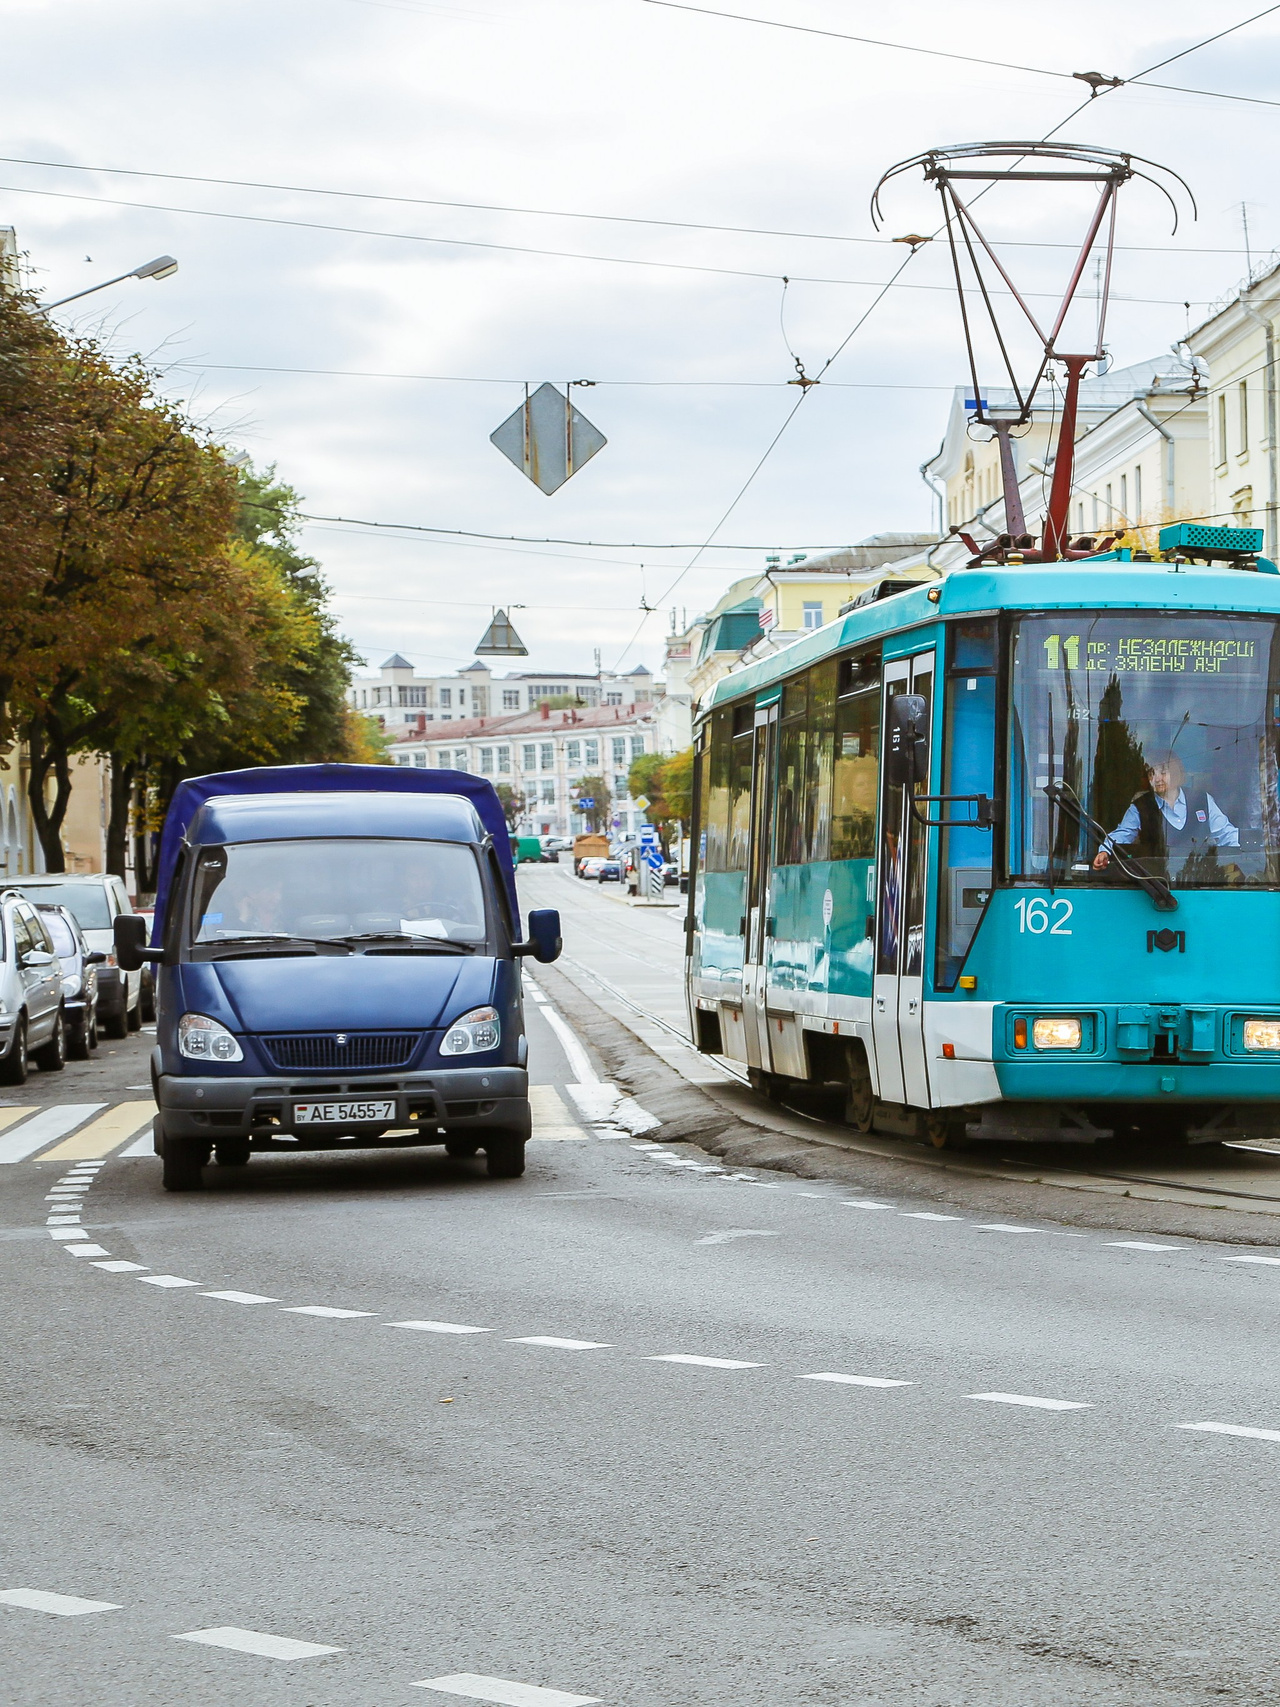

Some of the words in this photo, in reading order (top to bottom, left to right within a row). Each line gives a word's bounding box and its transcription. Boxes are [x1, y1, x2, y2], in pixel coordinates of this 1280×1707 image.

[1044, 634, 1080, 670] 11
[1014, 897, 1073, 935] 162
[310, 1105, 334, 1121] AE
[339, 1103, 392, 1120] 5455-7
